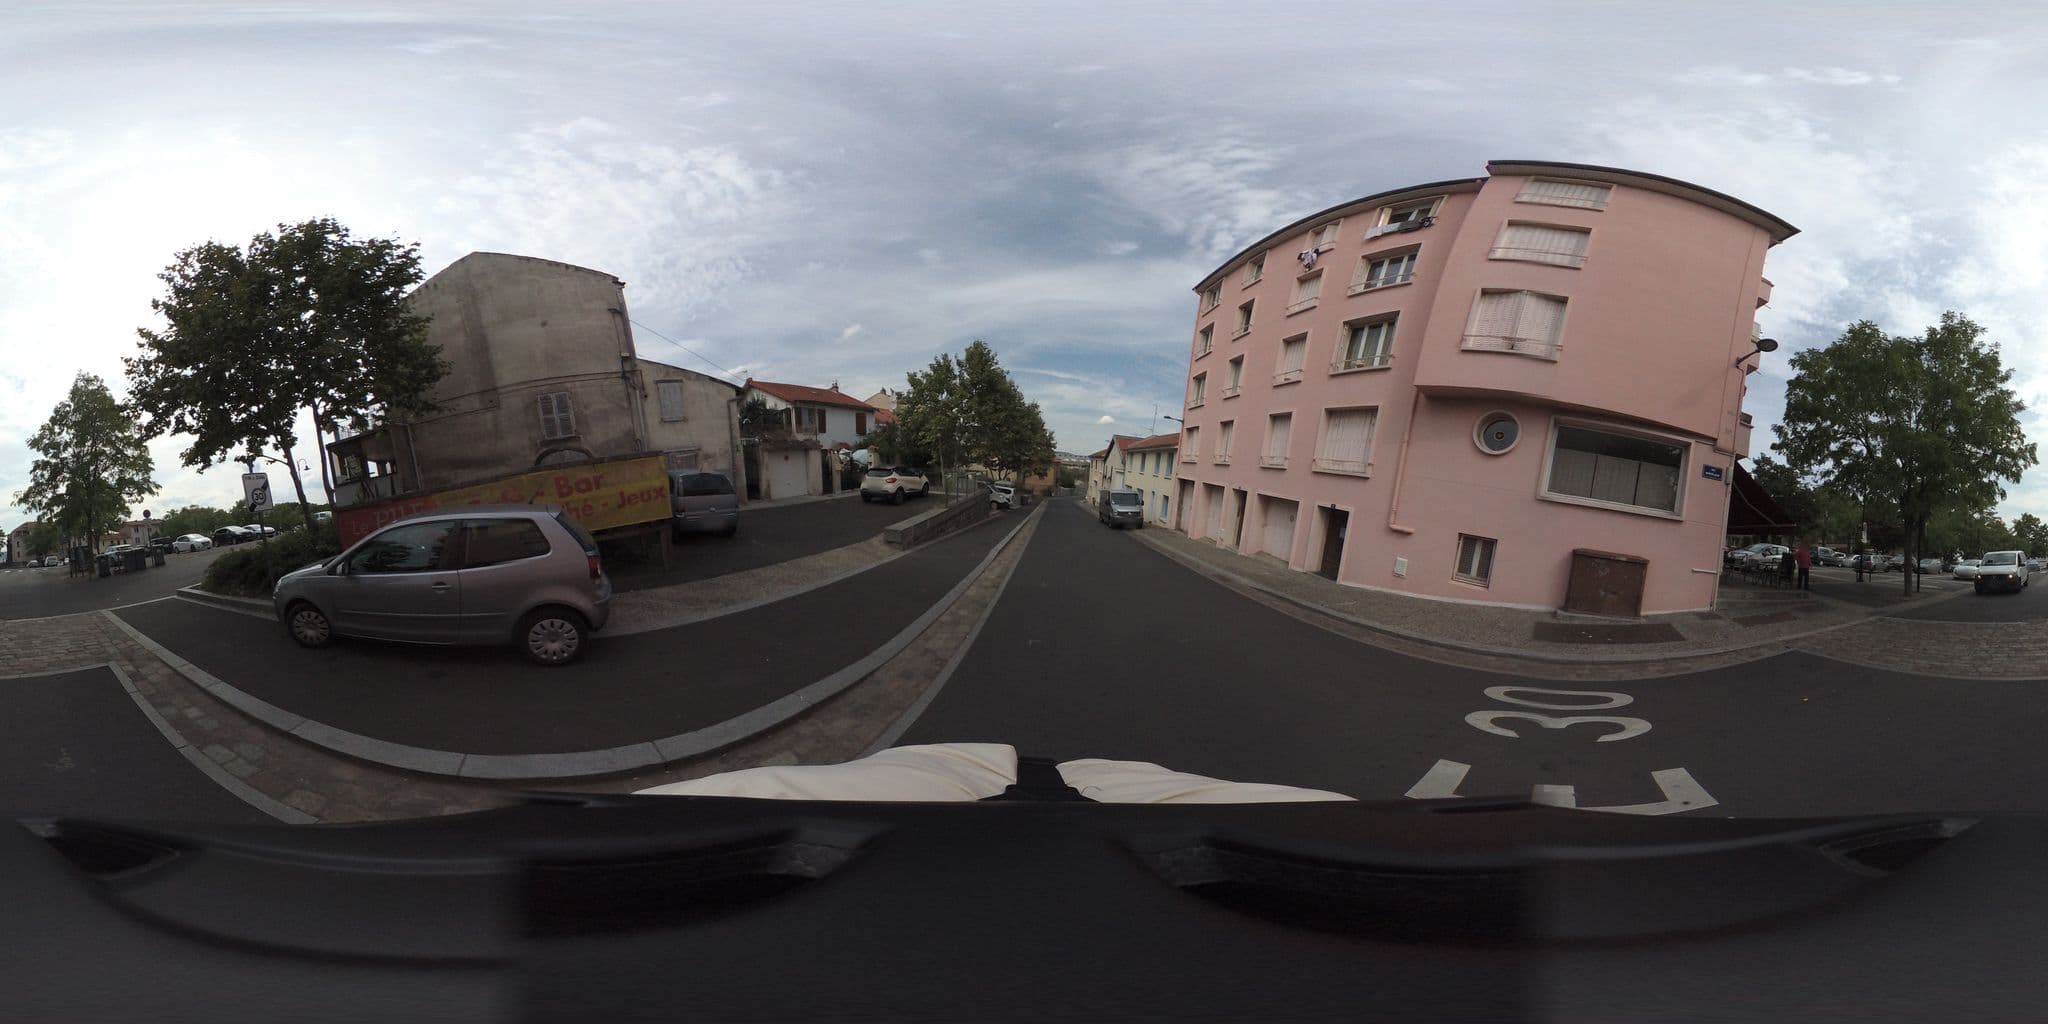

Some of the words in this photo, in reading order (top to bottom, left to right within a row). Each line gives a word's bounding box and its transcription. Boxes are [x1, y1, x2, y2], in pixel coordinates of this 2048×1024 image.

[254, 492, 264, 500] 30
[554, 472, 604, 498] Bar
[616, 486, 666, 509] Jeux
[1464, 685, 1653, 743] 30
